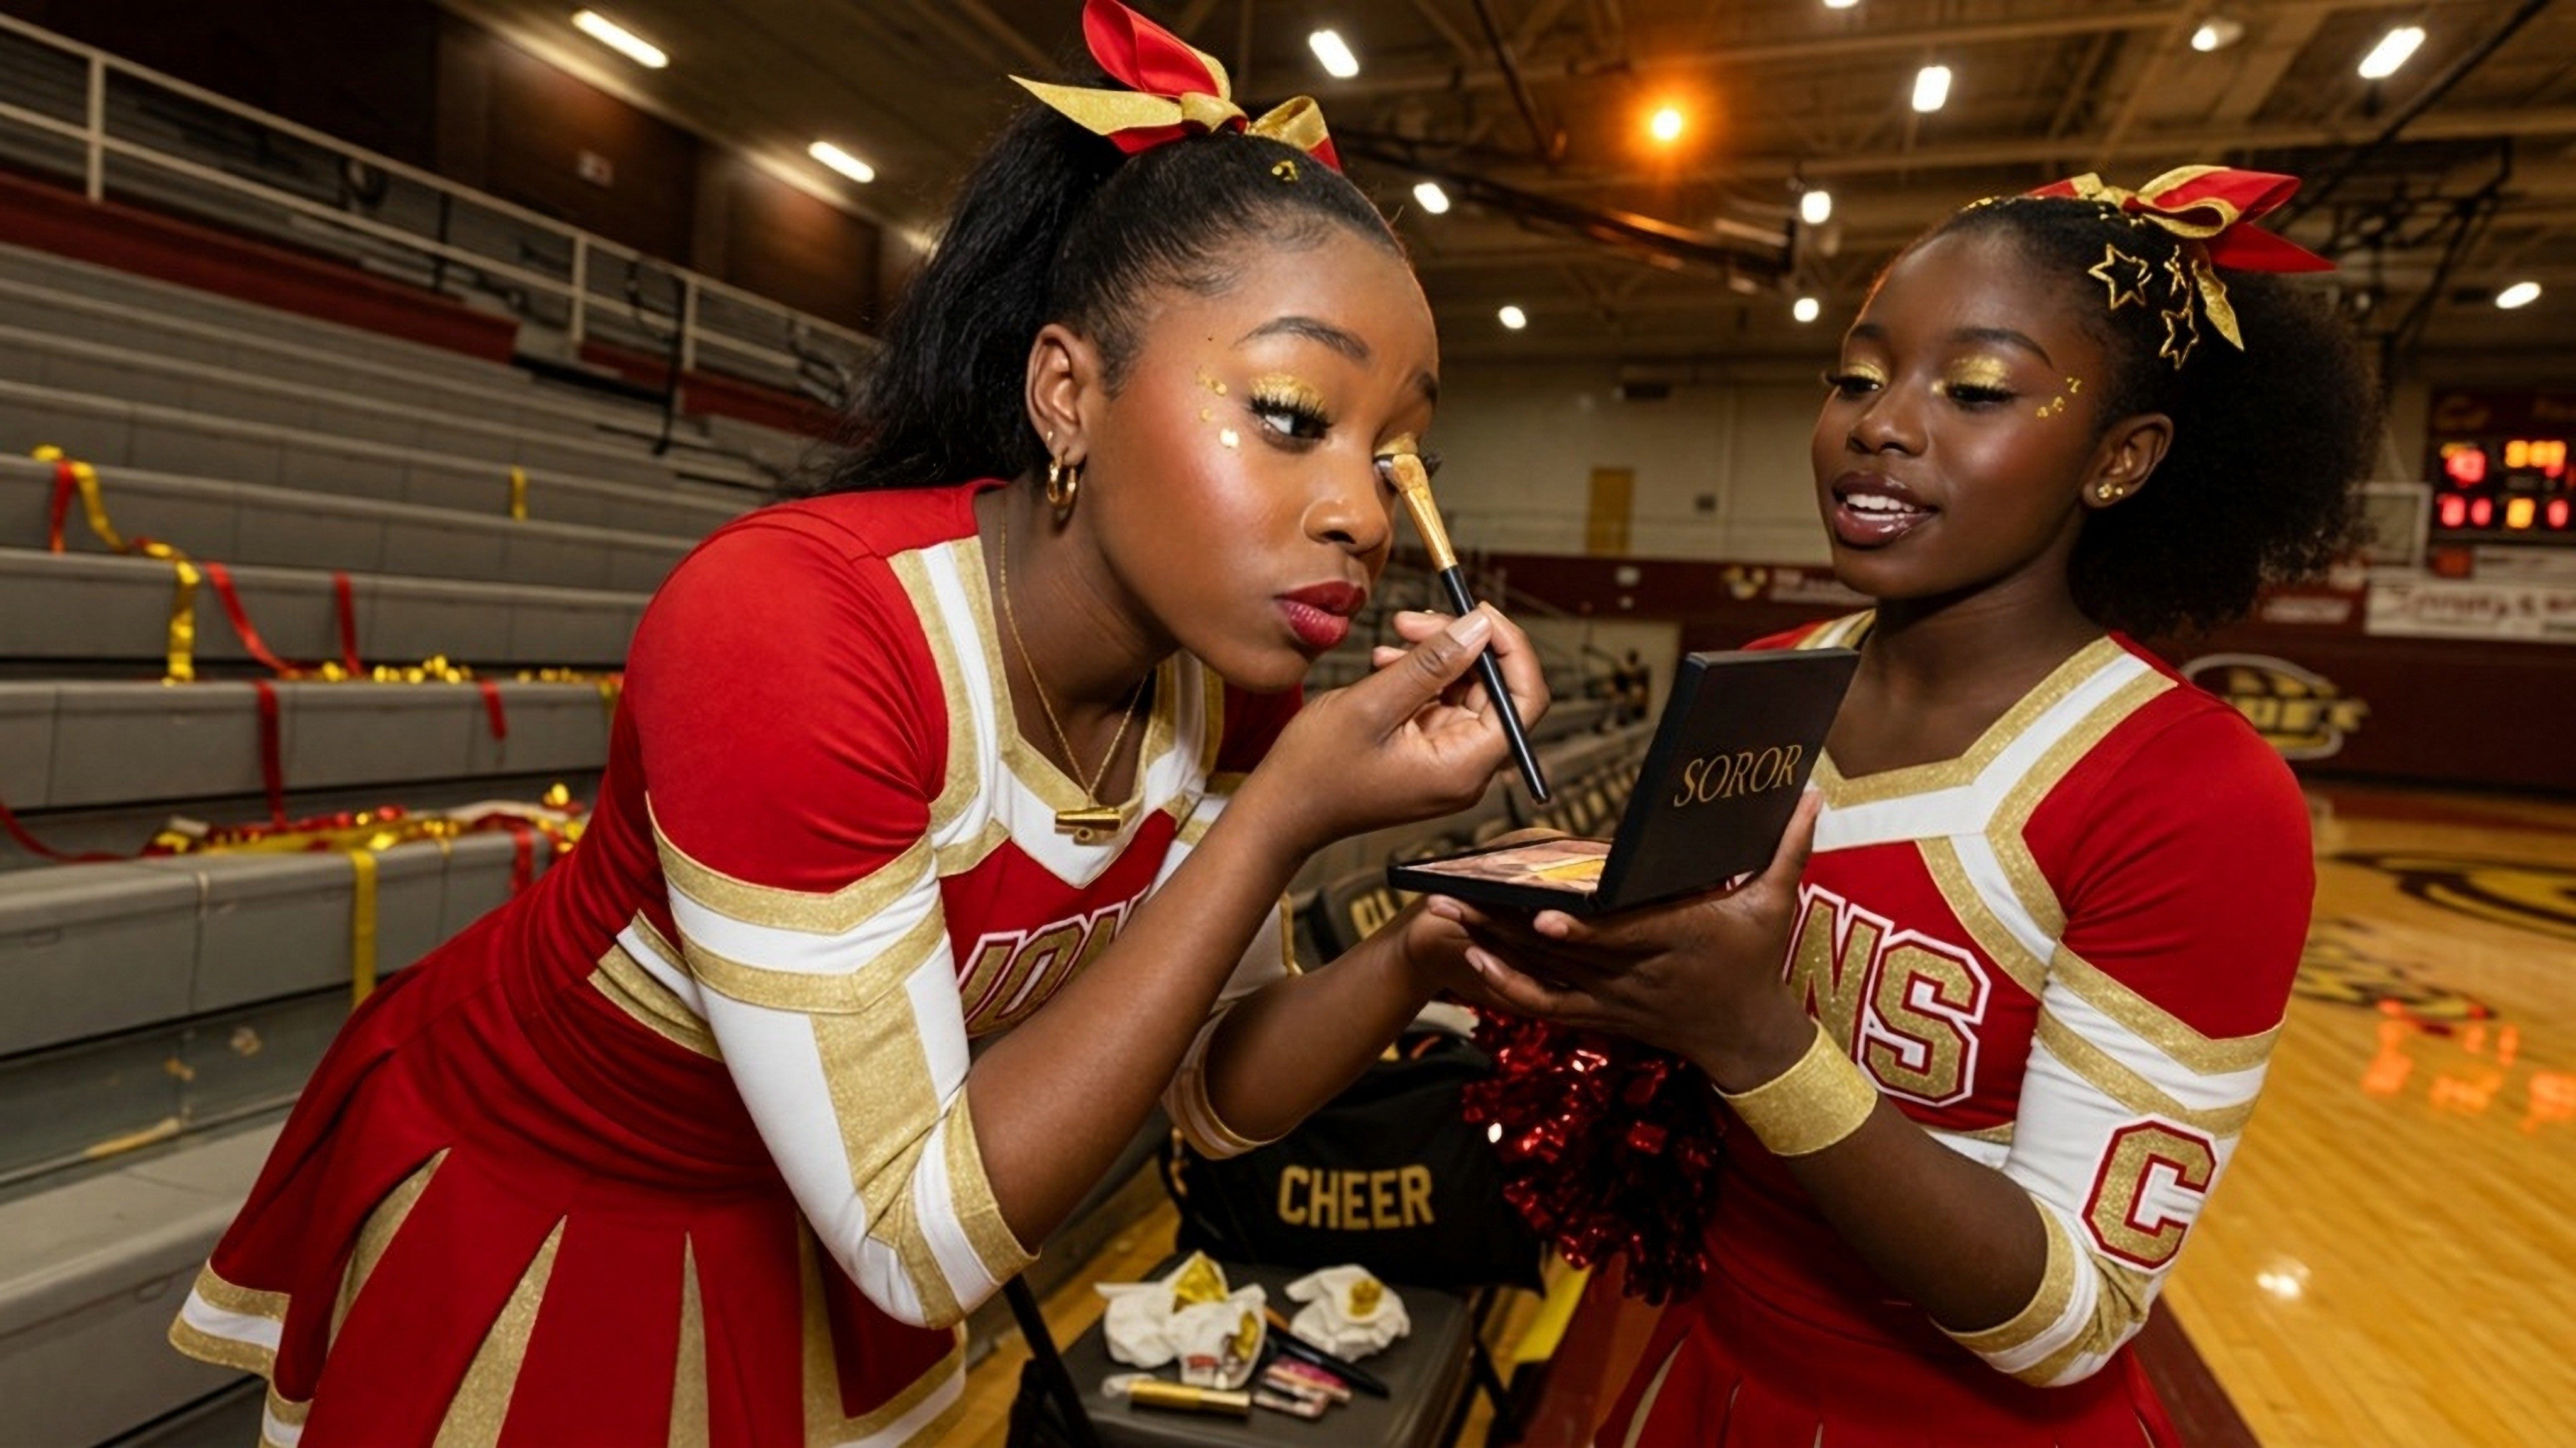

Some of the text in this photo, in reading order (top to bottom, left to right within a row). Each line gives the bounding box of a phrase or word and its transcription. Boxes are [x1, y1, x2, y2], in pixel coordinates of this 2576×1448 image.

[1673, 744, 1802, 807] SOROR
[1782, 883, 1992, 1108] NS
[1277, 1164, 1436, 1230] CHEER
[2077, 1112, 2218, 1274] C
